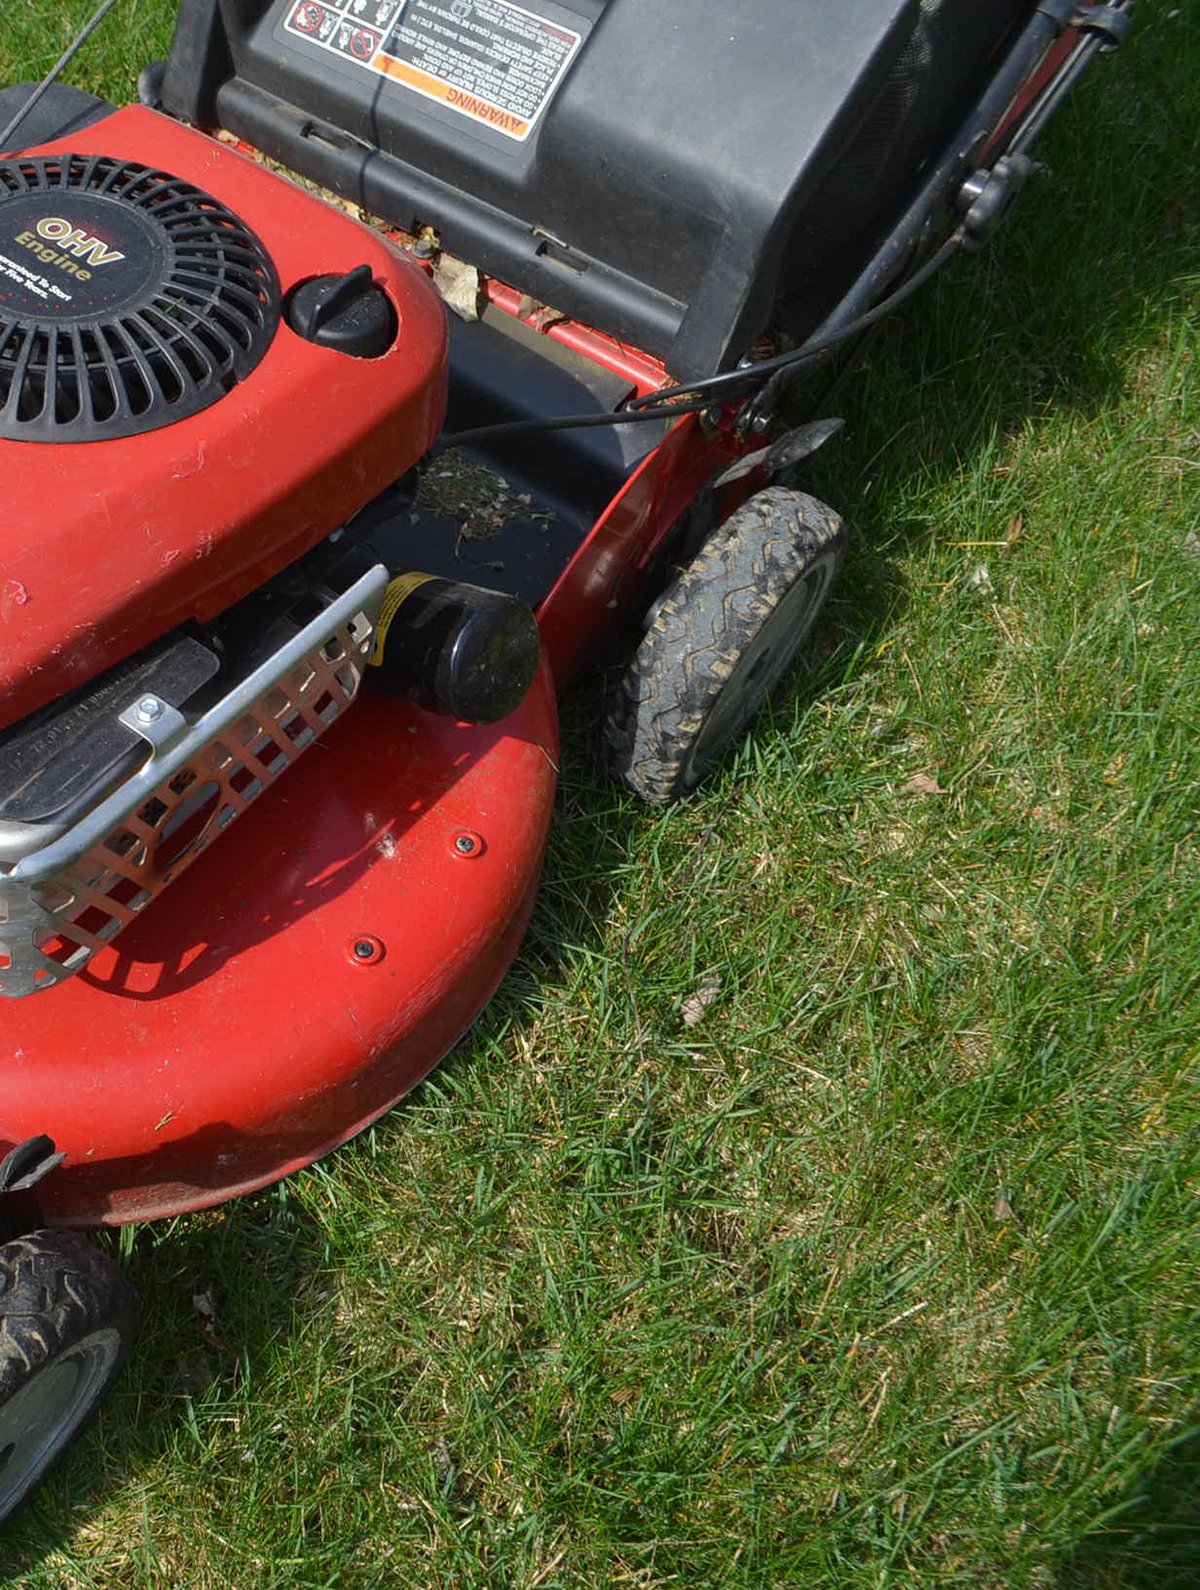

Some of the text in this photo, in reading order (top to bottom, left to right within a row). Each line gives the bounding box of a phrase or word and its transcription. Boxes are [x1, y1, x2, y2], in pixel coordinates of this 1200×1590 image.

[445, 88, 511, 128] WARNING
[14, 230, 92, 281] Engine
[37, 217, 125, 266] OHV
[38, 277, 49, 288] To
[48, 285, 72, 301] Start
